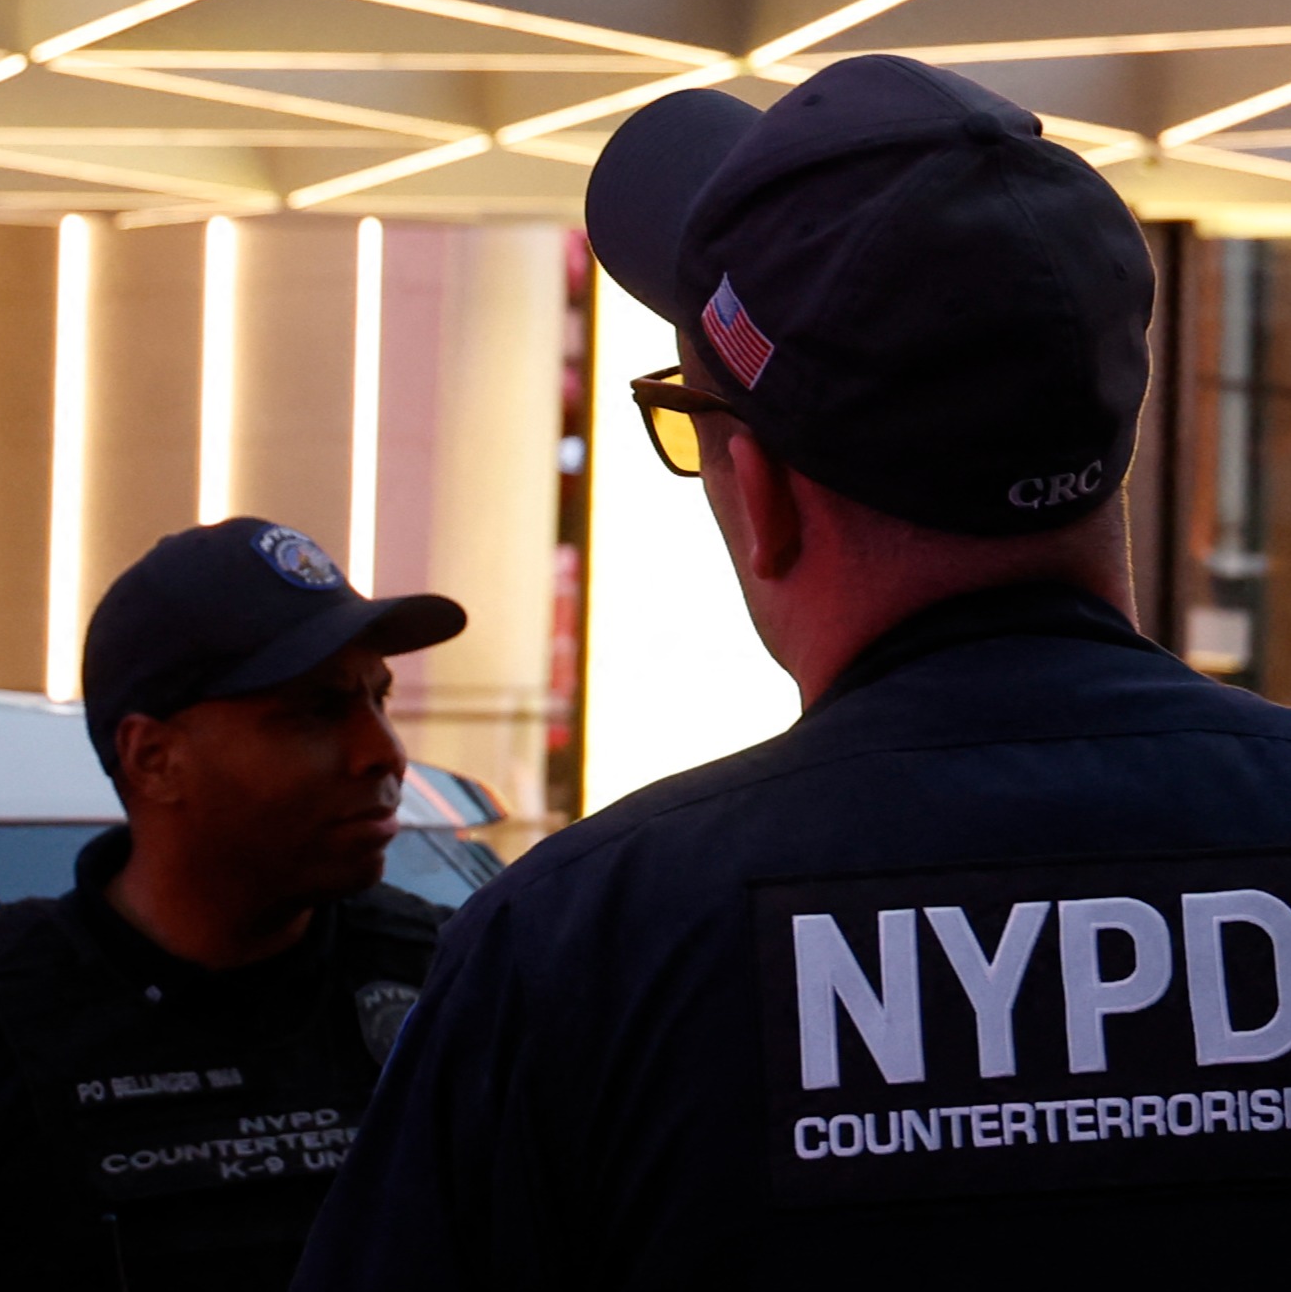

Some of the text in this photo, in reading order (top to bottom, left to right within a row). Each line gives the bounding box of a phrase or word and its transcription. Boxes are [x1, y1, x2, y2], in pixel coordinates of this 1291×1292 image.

[76, 1079, 106, 1104] PO
[239, 1107, 340, 1135] NYPD
[220, 1148, 350, 1180] K-9 UN
